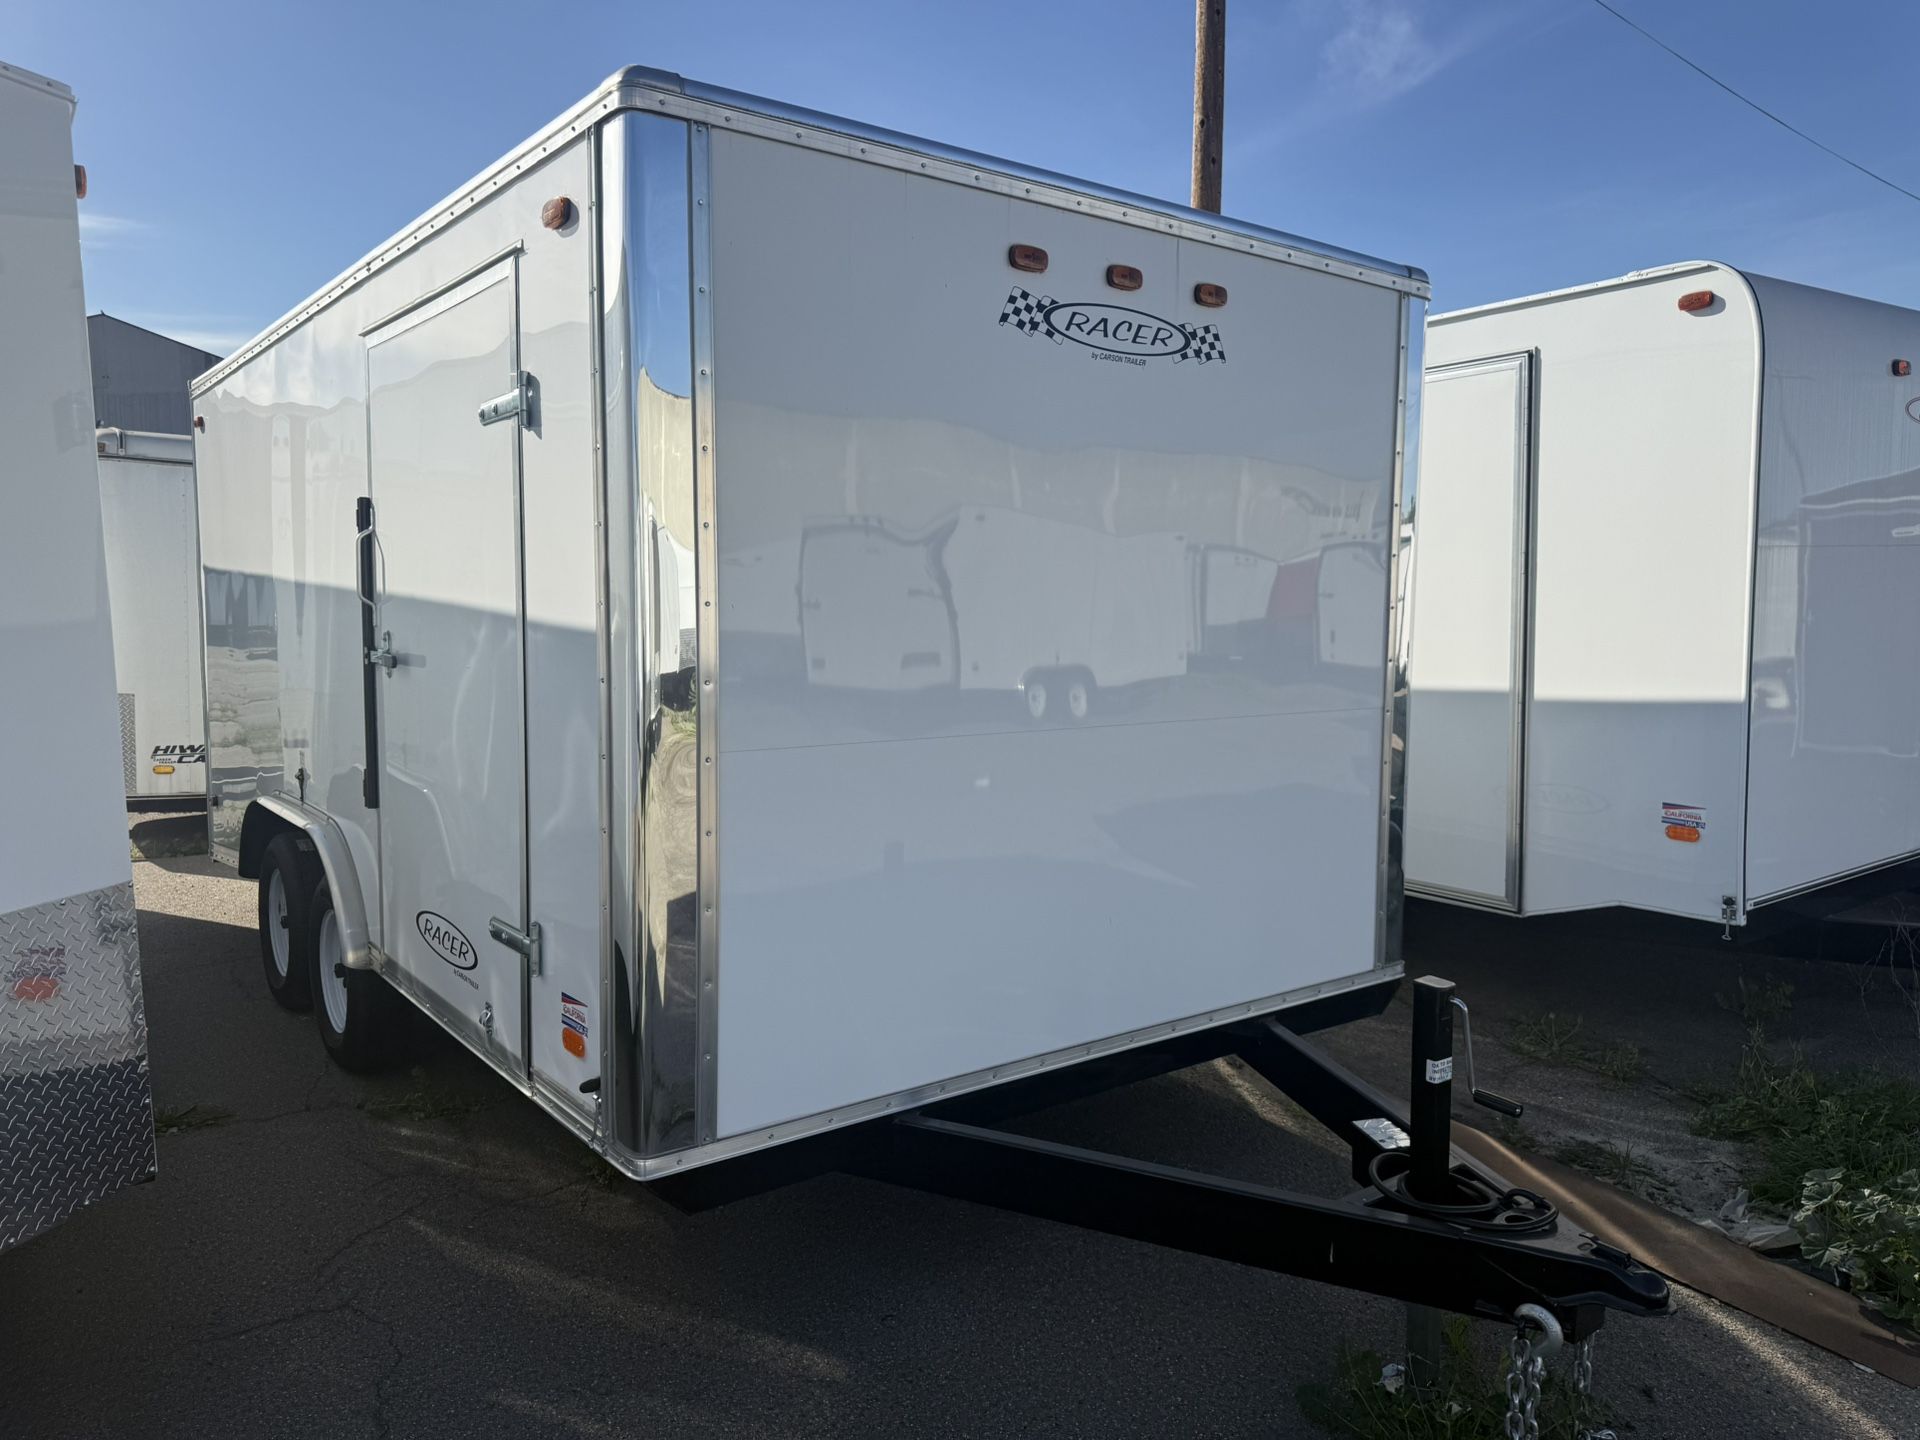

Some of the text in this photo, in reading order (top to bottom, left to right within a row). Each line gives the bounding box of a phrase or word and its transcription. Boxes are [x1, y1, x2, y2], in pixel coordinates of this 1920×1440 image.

[1065, 311, 1173, 347] RACER
[1091, 351, 1147, 366] by CARSON TRAILER
[1664, 810, 1702, 821] CALIFORNIA
[424, 918, 469, 961] RACER
